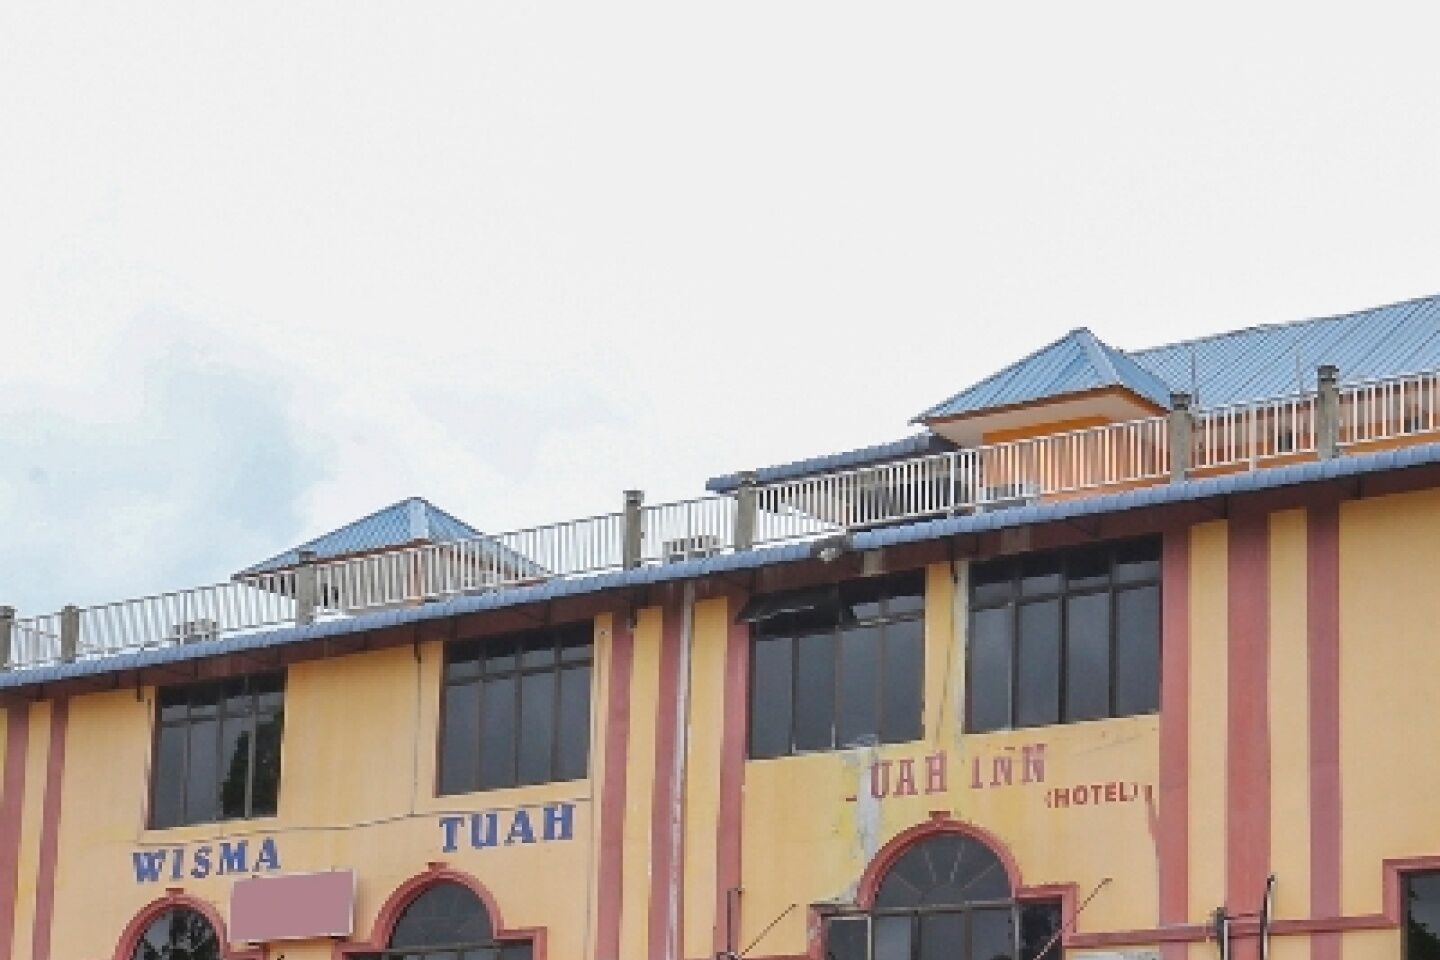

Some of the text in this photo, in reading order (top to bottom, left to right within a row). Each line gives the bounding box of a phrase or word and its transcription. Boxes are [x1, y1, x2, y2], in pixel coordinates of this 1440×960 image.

[844, 743, 1049, 803] UAH INN
[133, 802, 578, 884] WISMA TUAH
